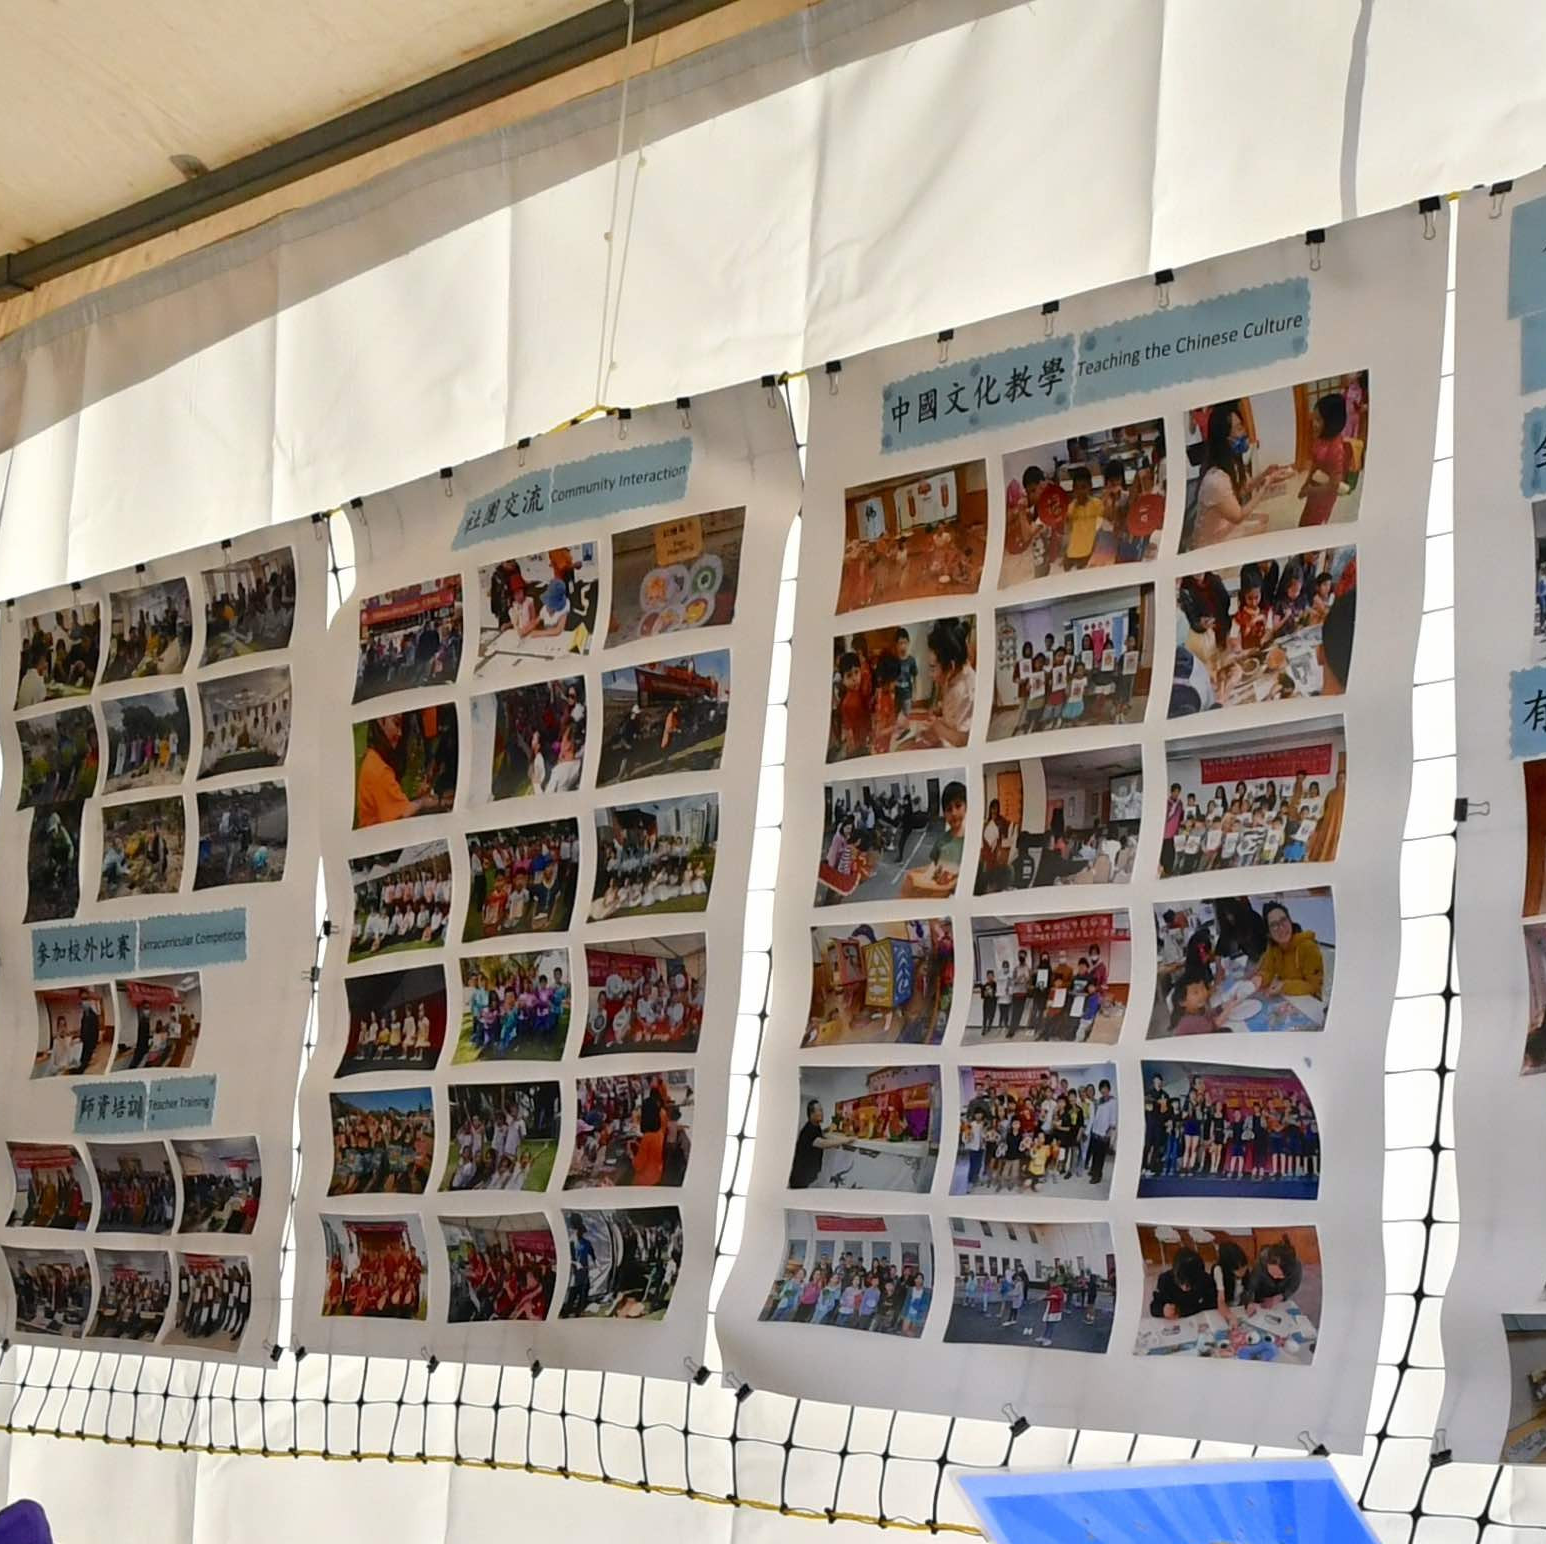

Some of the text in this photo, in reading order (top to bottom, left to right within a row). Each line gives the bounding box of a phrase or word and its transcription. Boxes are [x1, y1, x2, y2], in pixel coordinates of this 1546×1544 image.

[1078, 313, 1303, 377] Teaching the Chinese Culture
[891, 356, 1066, 433] 中國文化教學
[464, 484, 544, 535] 社團交流
[550, 464, 687, 504] Community Interaction
[195, 930, 246, 947] Competition
